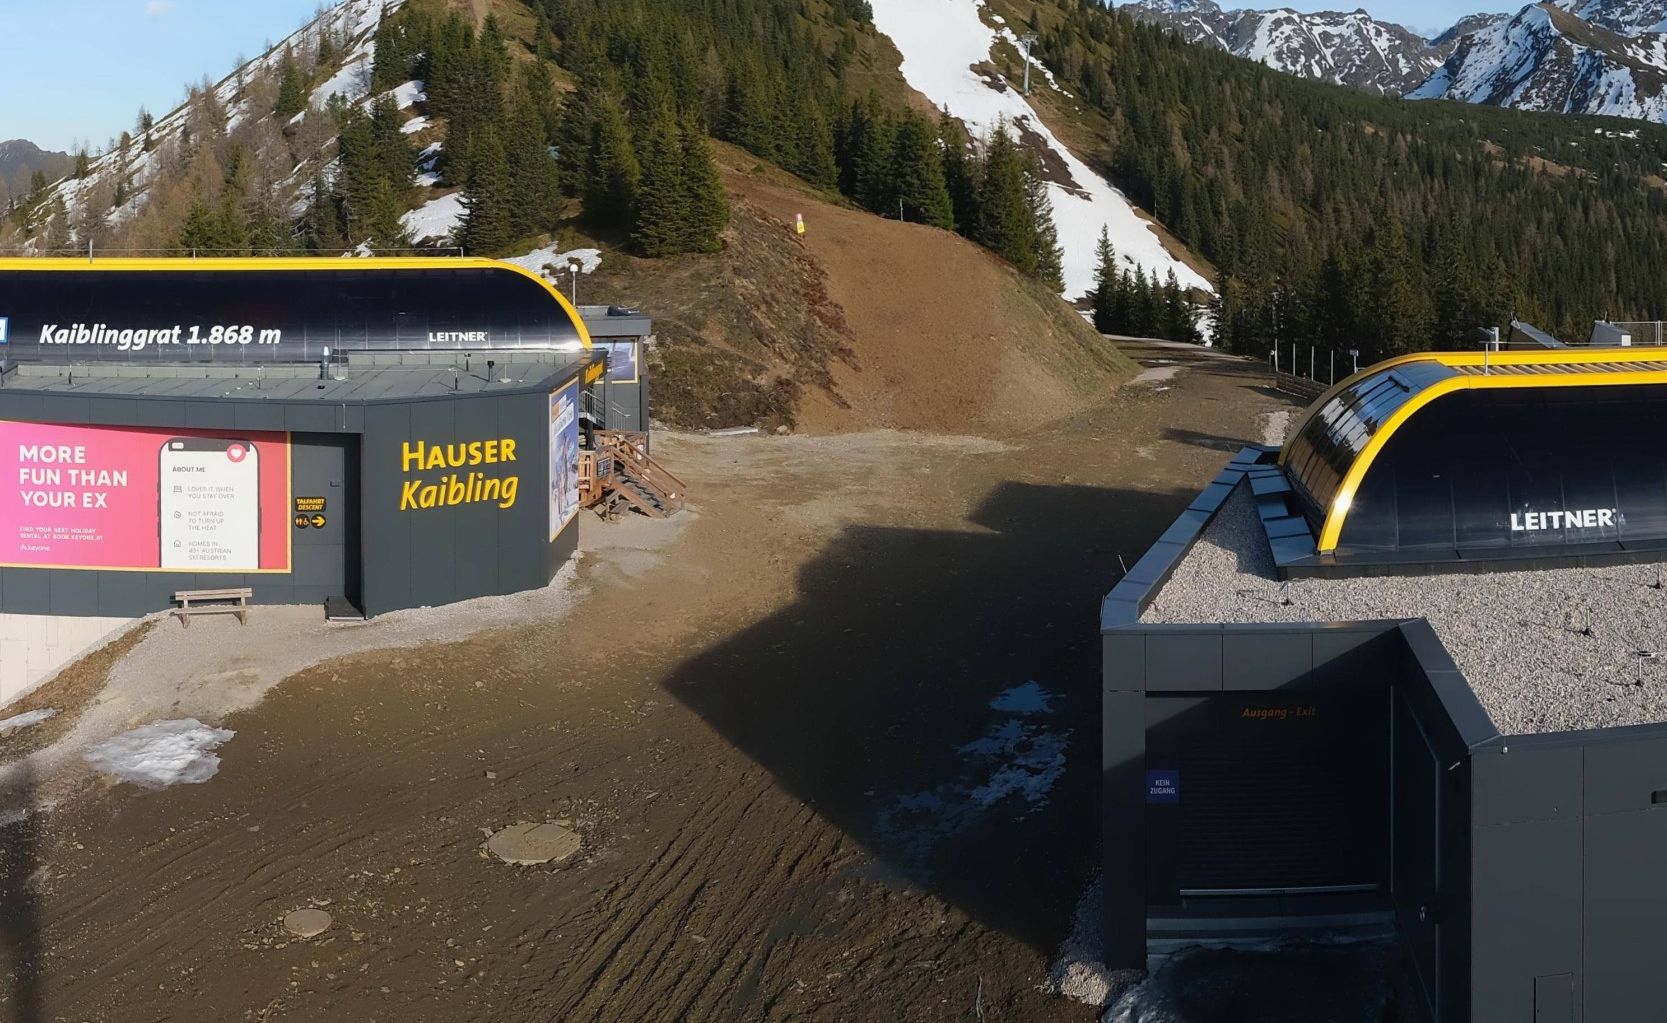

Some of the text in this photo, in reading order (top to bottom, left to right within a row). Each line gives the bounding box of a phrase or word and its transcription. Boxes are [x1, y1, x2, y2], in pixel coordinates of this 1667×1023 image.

[39, 323, 282, 351] Kaiblinggrat 1.868 m
[428, 331, 486, 342] LEITNER
[20, 445, 86, 463] MORE
[402, 438, 517, 472] HAUSER
[20, 468, 128, 486] FUN THAN
[20, 491, 108, 508] YOUR EX
[400, 472, 519, 511] Kaibling
[1510, 508, 1614, 531] LEITNER
[1241, 708, 1287, 720] Ausgang
[1296, 707, 1316, 716] Exit
